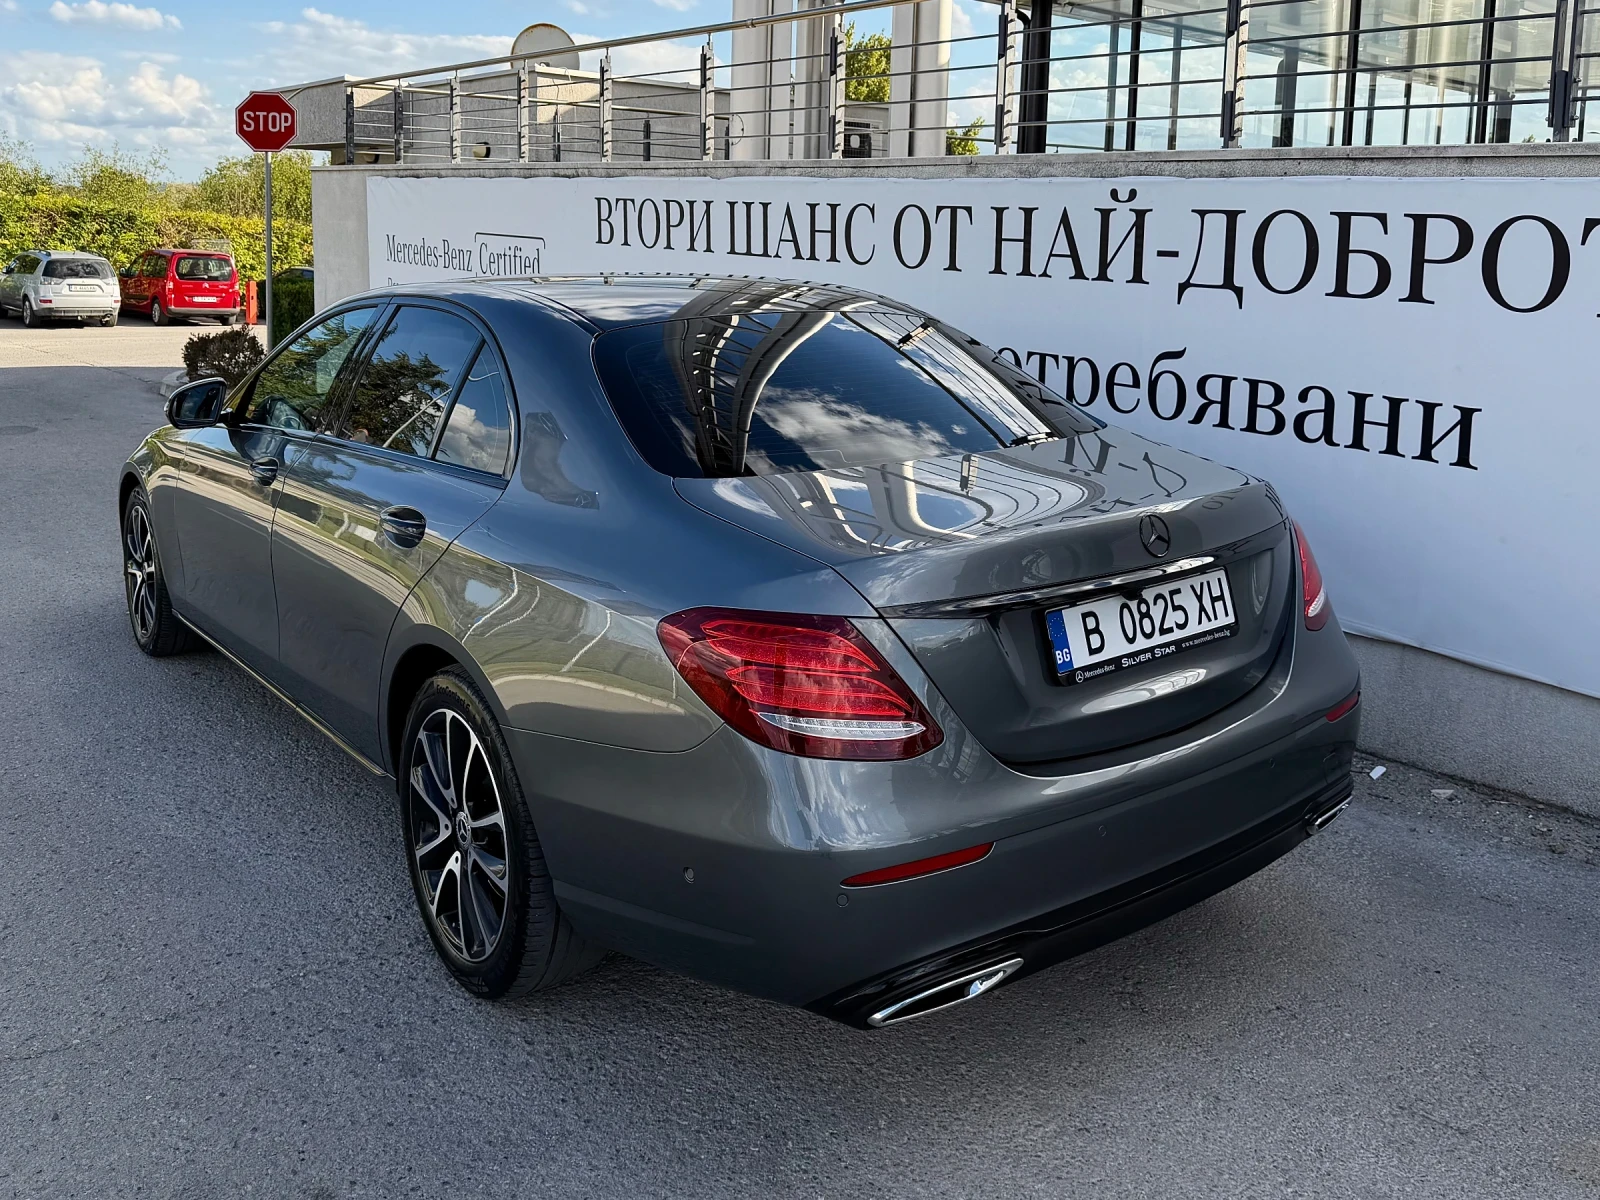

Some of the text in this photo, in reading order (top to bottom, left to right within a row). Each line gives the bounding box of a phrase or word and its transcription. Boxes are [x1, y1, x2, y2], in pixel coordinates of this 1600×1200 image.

[243, 111, 292, 132] STOP
[386, 234, 541, 275] Mercedes-Benz Certified
[594, 188, 1600, 318] ВТОРИ ШАНС ОТ НАЙ-ДОБРО
[1081, 577, 1230, 656] B 0825 XH
[1056, 648, 1071, 664] BG
[1121, 645, 1177, 668] SILVER STAR
[1084, 664, 1116, 679] Mercedes-Benz
